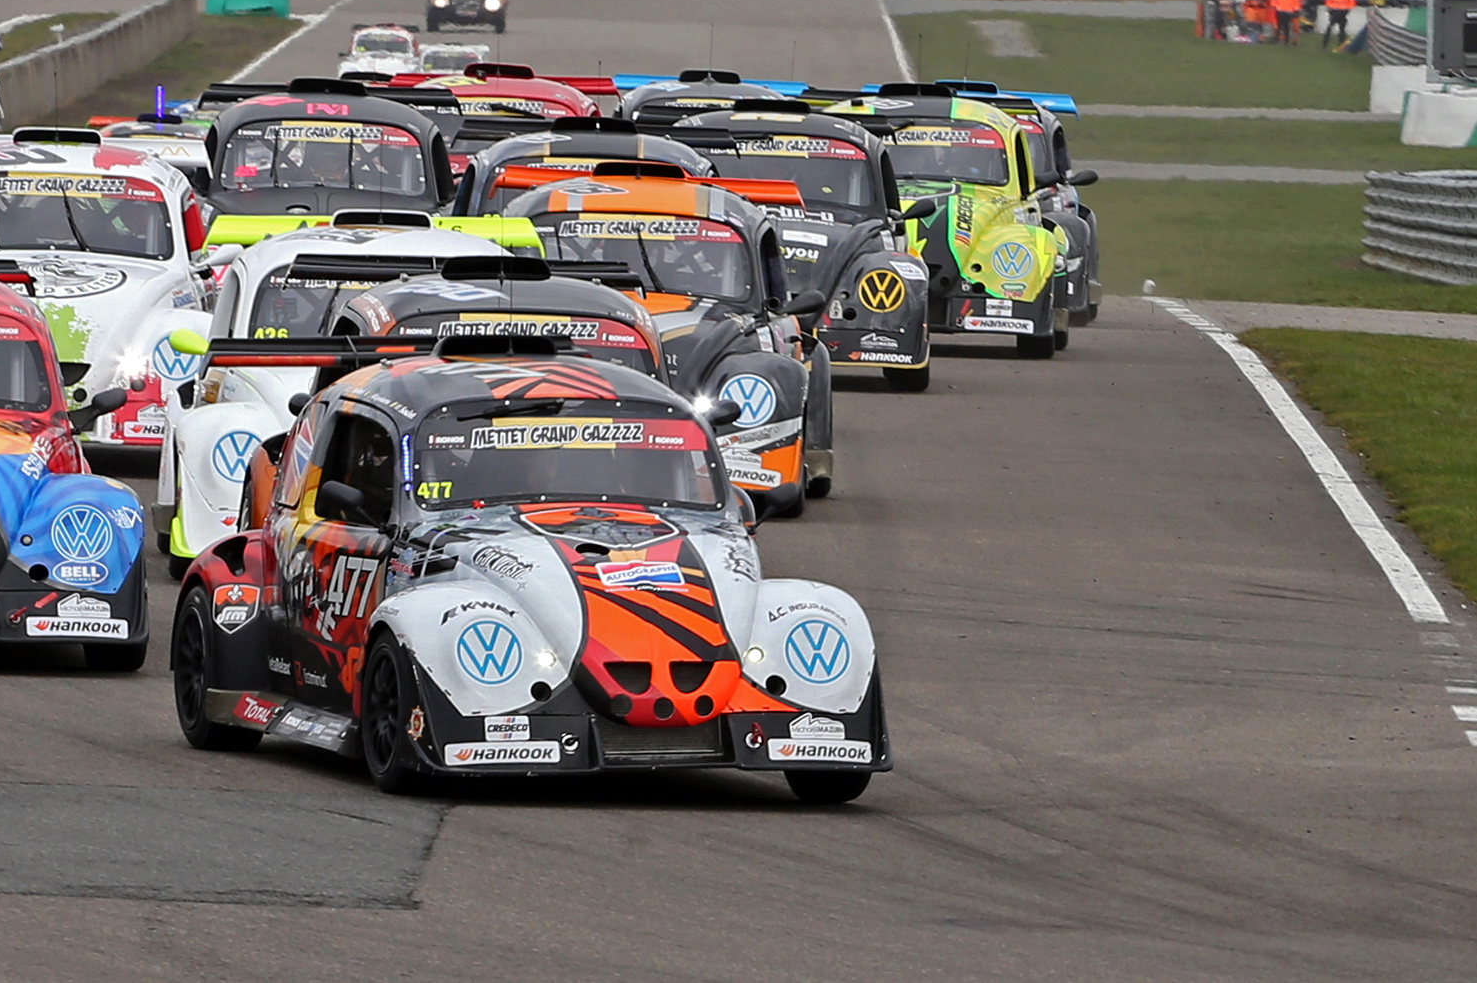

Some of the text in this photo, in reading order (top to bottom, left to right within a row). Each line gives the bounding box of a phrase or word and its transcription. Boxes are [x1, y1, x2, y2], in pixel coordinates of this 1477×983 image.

[265, 125, 304, 140] METTET
[306, 126, 338, 139] GRAND
[35, 177, 73, 193] GRAND
[76, 177, 126, 193] GAZZZZ
[559, 221, 605, 237] METTET
[607, 221, 646, 235] GRAND
[648, 221, 700, 236] GAZZZZ
[59, 270, 122, 296] SELTZER
[438, 321, 493, 337] METTET
[495, 321, 541, 336] GRAND
[542, 322, 599, 339] GAZZZZ
[470, 426, 528, 448] METTET
[530, 424, 579, 445] GRAND
[580, 421, 643, 443] GAZZZZ
[726, 468, 777, 484] ankook
[416, 480, 453, 499] 477
[60, 565, 101, 578] BELL
[605, 564, 679, 583] AUTOGRAPHE
[327, 555, 380, 619] 477
[486, 723, 530, 733] CREDECO
